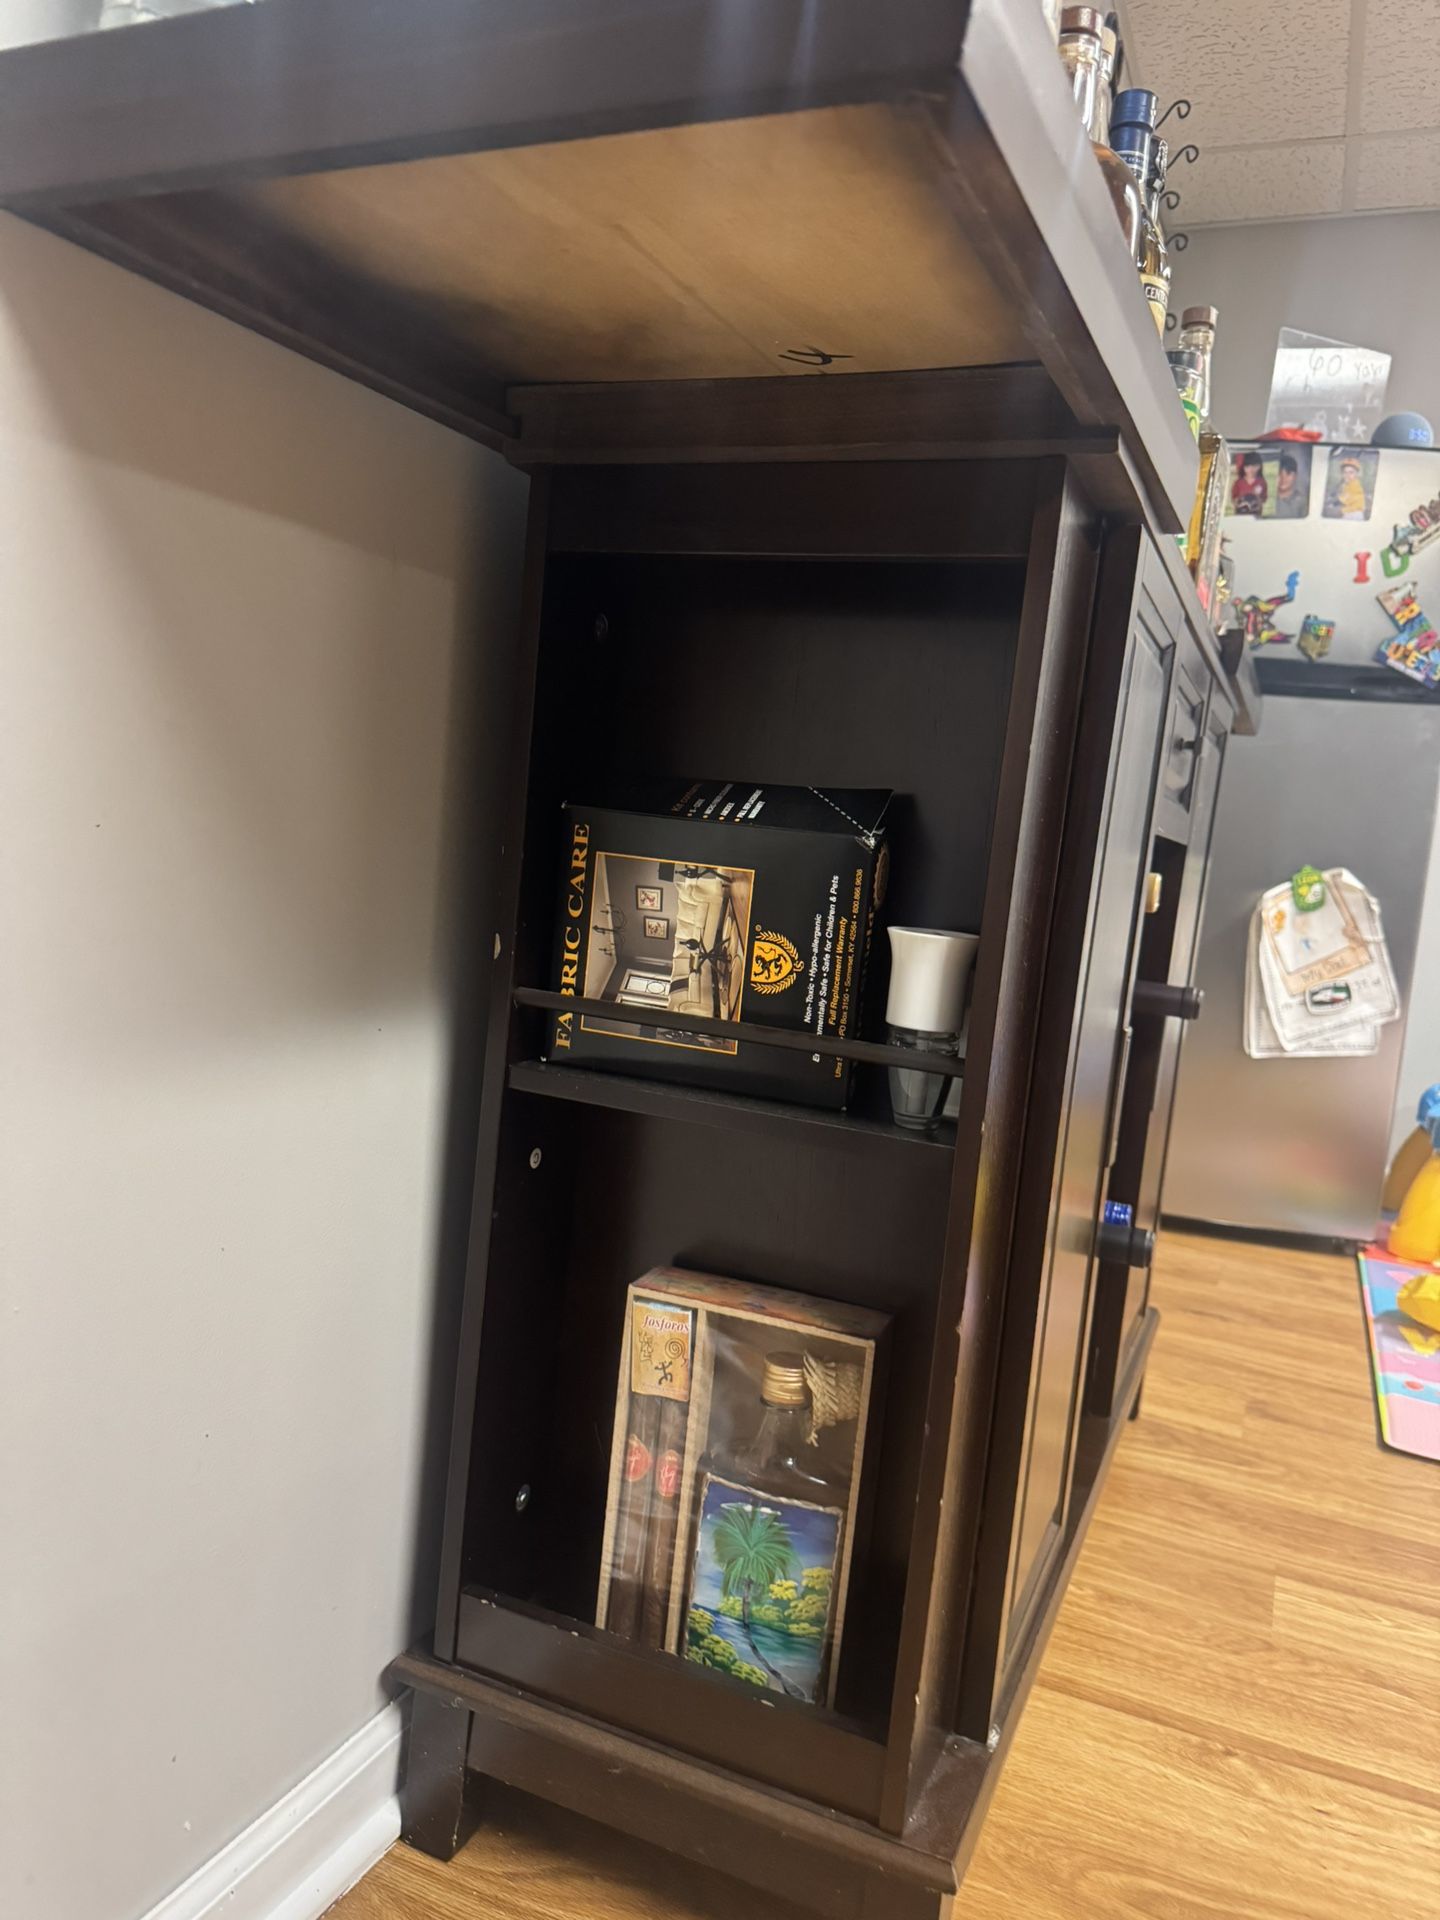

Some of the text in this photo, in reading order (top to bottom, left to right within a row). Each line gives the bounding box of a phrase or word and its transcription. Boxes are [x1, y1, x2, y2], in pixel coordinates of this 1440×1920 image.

[567, 823, 590, 918] CARE
[829, 874, 839, 895] Pets
[825, 903, 836, 939] Children
[824, 939, 833, 952] for
[804, 913, 822, 1024] Non-Toxic Hypo-allergenic
[822, 953, 831, 973] Safe
[828, 916, 848, 1026] Full Replacement Warranty
[819, 978, 829, 997] Safe
